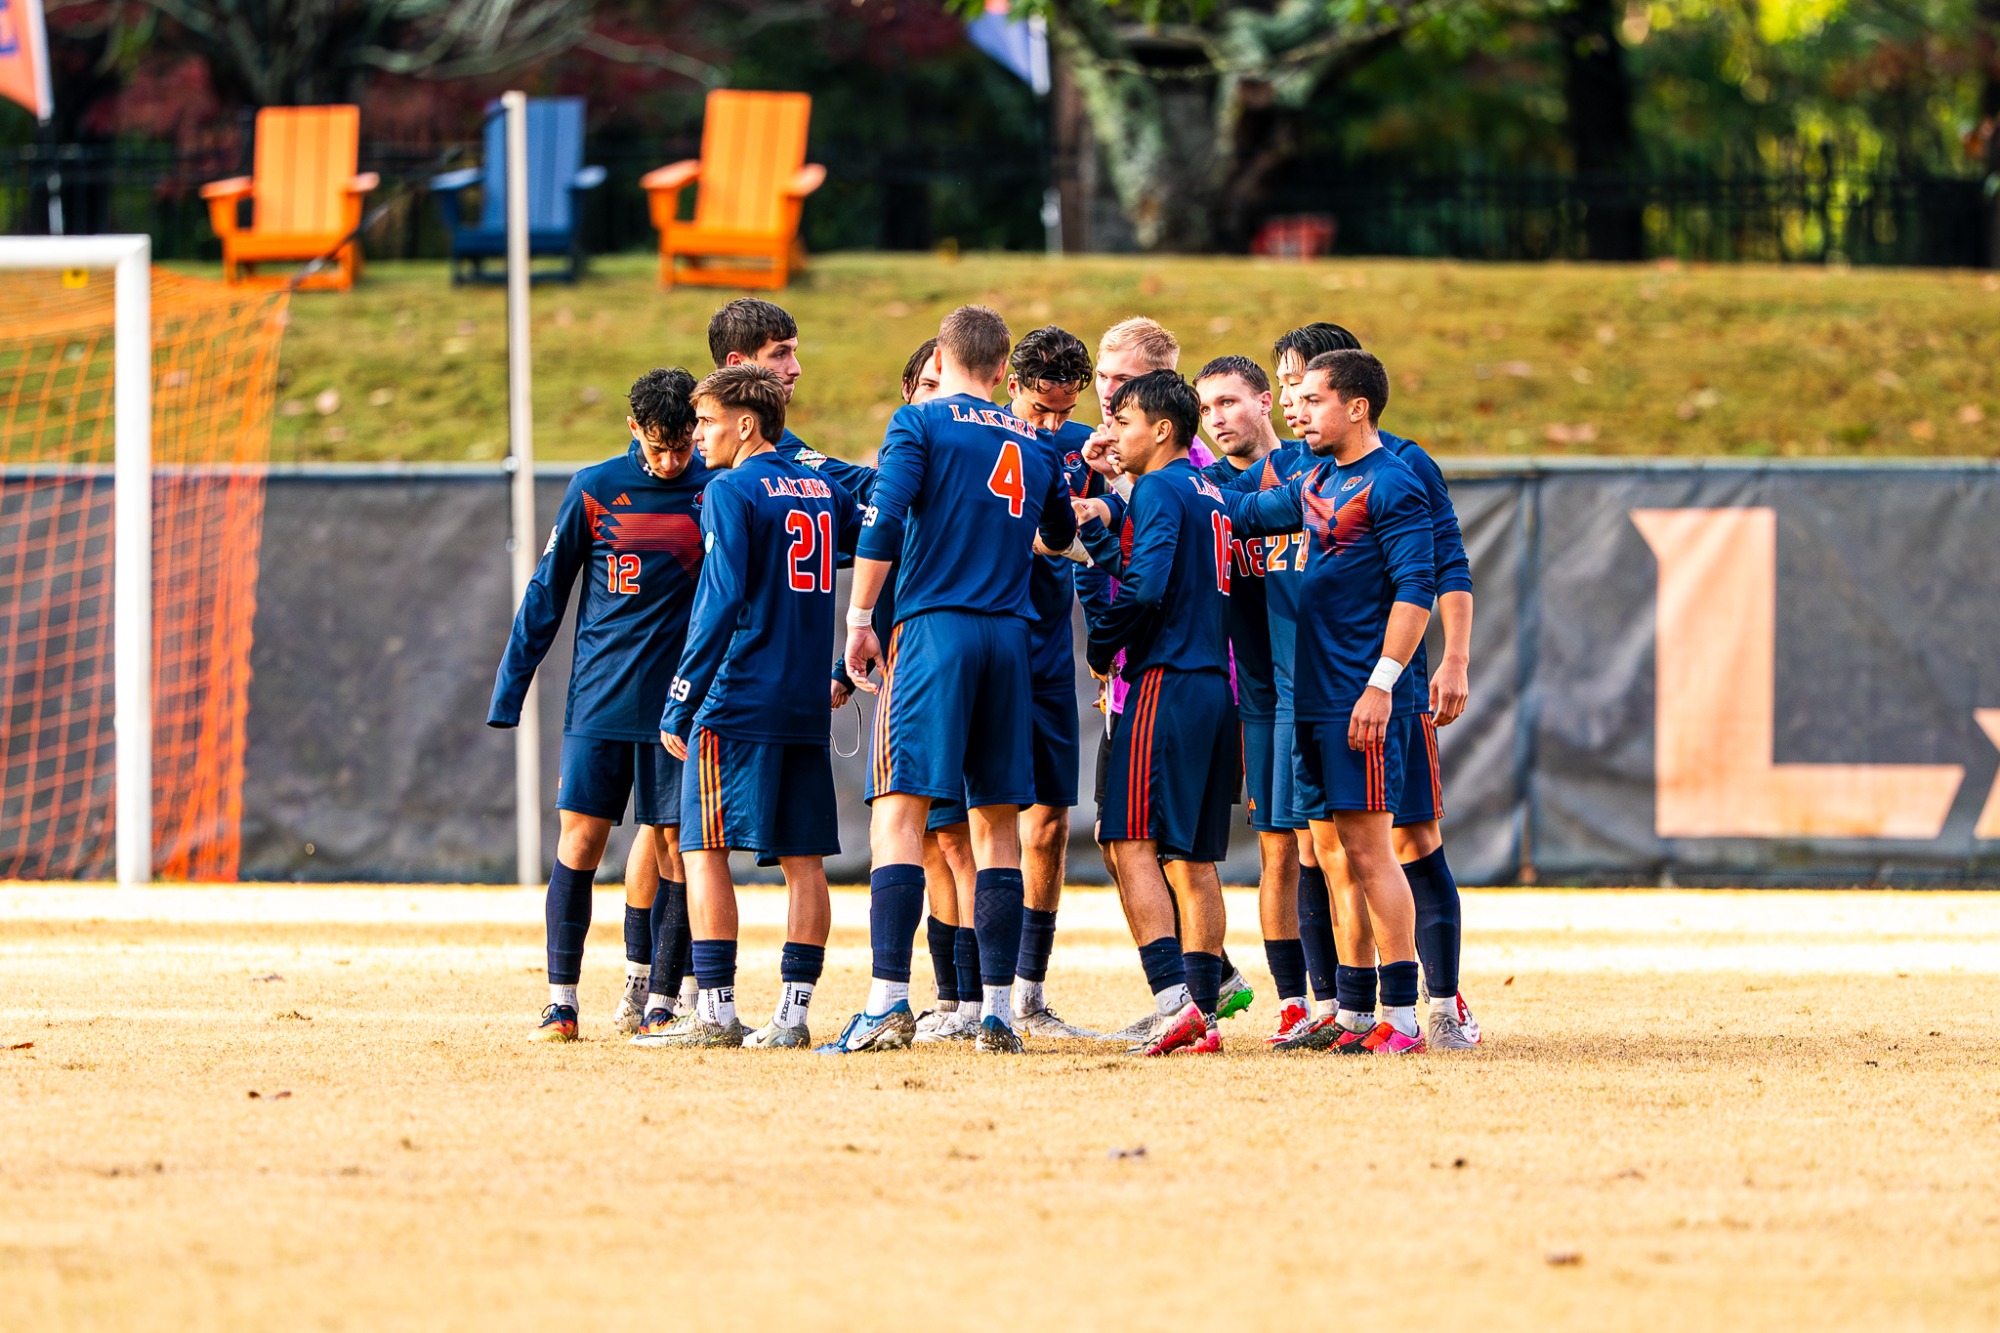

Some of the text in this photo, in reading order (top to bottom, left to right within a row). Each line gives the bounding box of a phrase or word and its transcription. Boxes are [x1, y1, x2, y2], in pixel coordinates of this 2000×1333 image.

[949, 404, 1037, 441] LAKERS
[761, 476, 832, 499] LAKERS
[987, 440, 1025, 519] 4
[785, 509, 832, 594] 21
[1231, 537, 1265, 577] 18
[1265, 529, 1305, 572] 27
[606, 554, 641, 595] 12
[670, 675, 691, 702] 29
[1630, 507, 2000, 840] L
